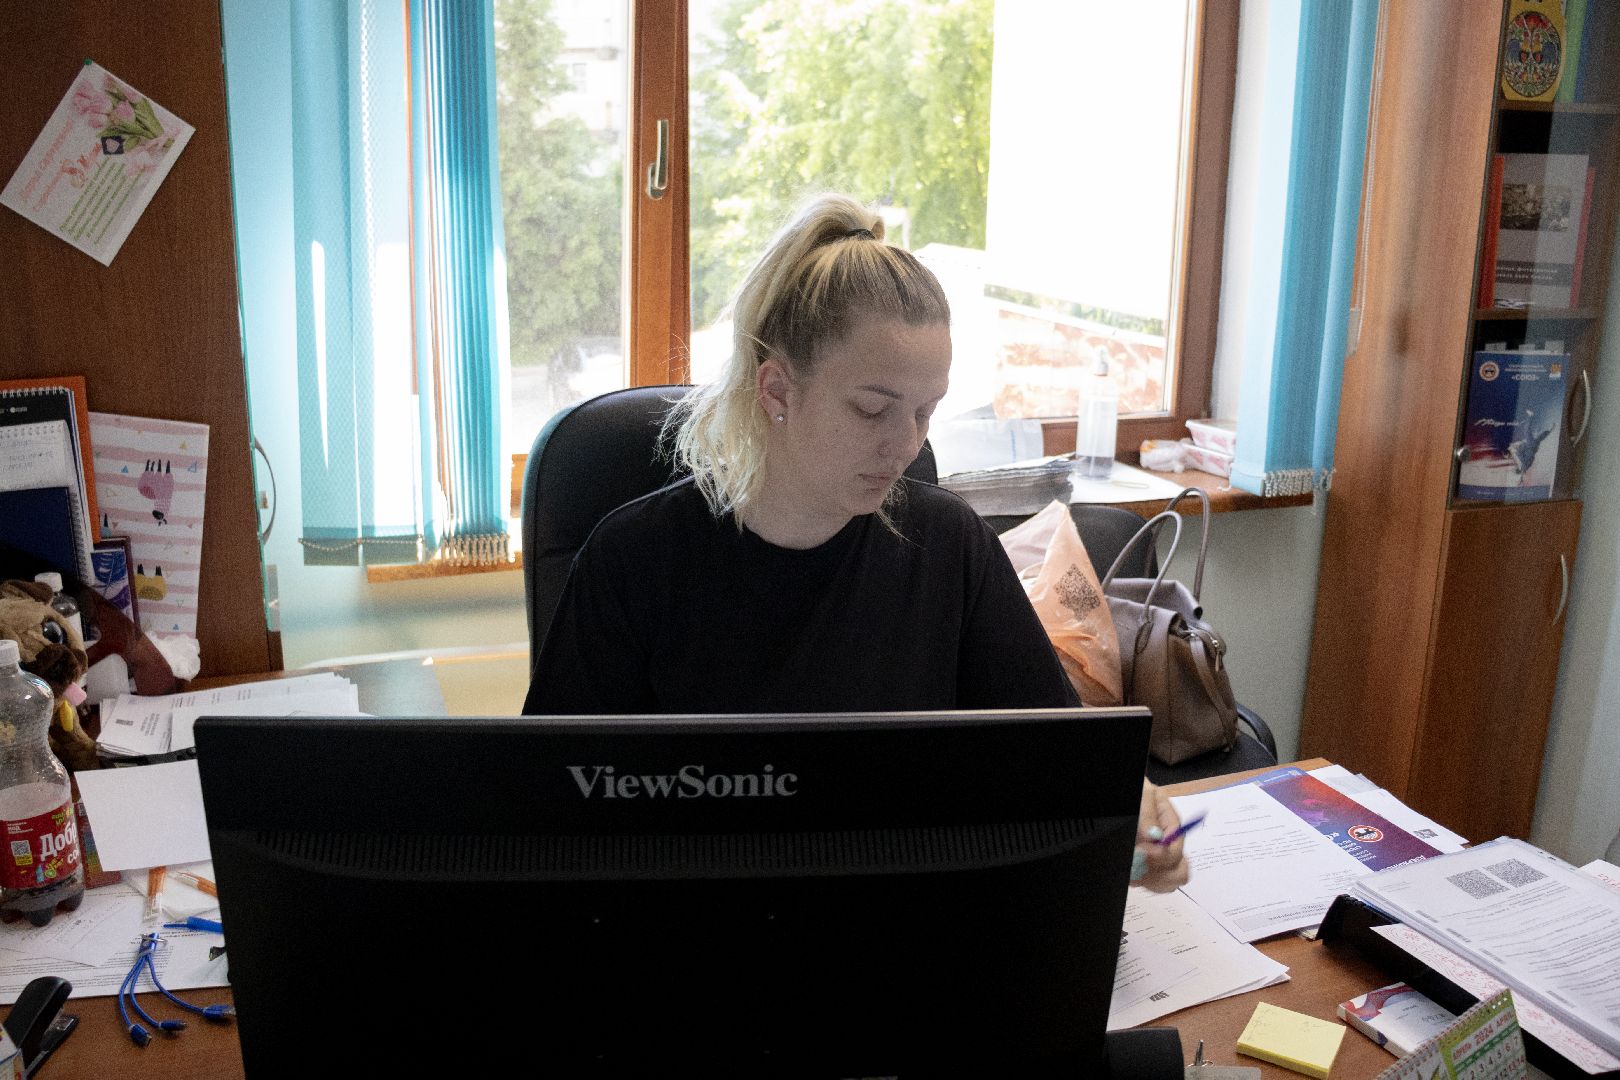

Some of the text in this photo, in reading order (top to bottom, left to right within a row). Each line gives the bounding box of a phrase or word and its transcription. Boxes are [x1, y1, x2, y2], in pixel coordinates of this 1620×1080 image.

[566, 764, 798, 799] ViewSonic
[1474, 1023, 1494, 1047] 2024
[1505, 1042, 1511, 1052] 6
